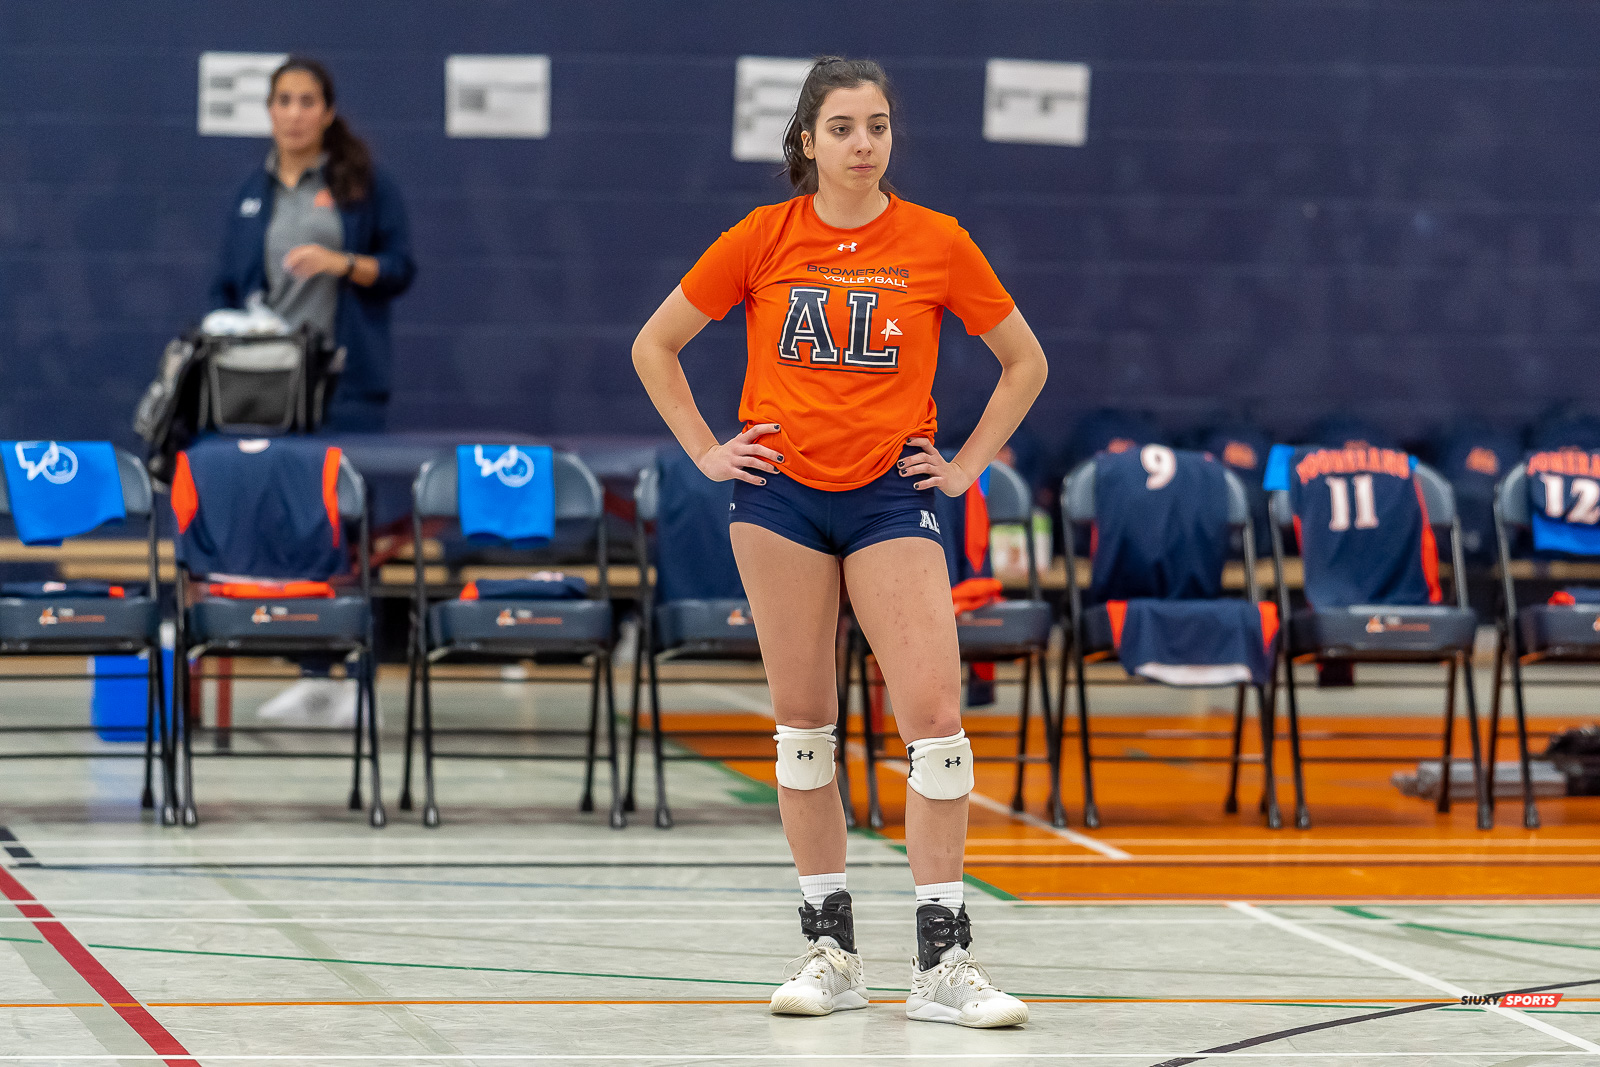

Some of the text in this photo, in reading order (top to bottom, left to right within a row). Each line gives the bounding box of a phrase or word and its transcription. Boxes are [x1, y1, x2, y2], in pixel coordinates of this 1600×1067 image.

[807, 264, 910, 278] BOOMERANG
[823, 275, 908, 288] VOLLEYBALL
[777, 286, 900, 368] AL
[1140, 444, 1177, 490] 9
[1325, 474, 1379, 532] 11
[1540, 473, 1600, 525] 12
